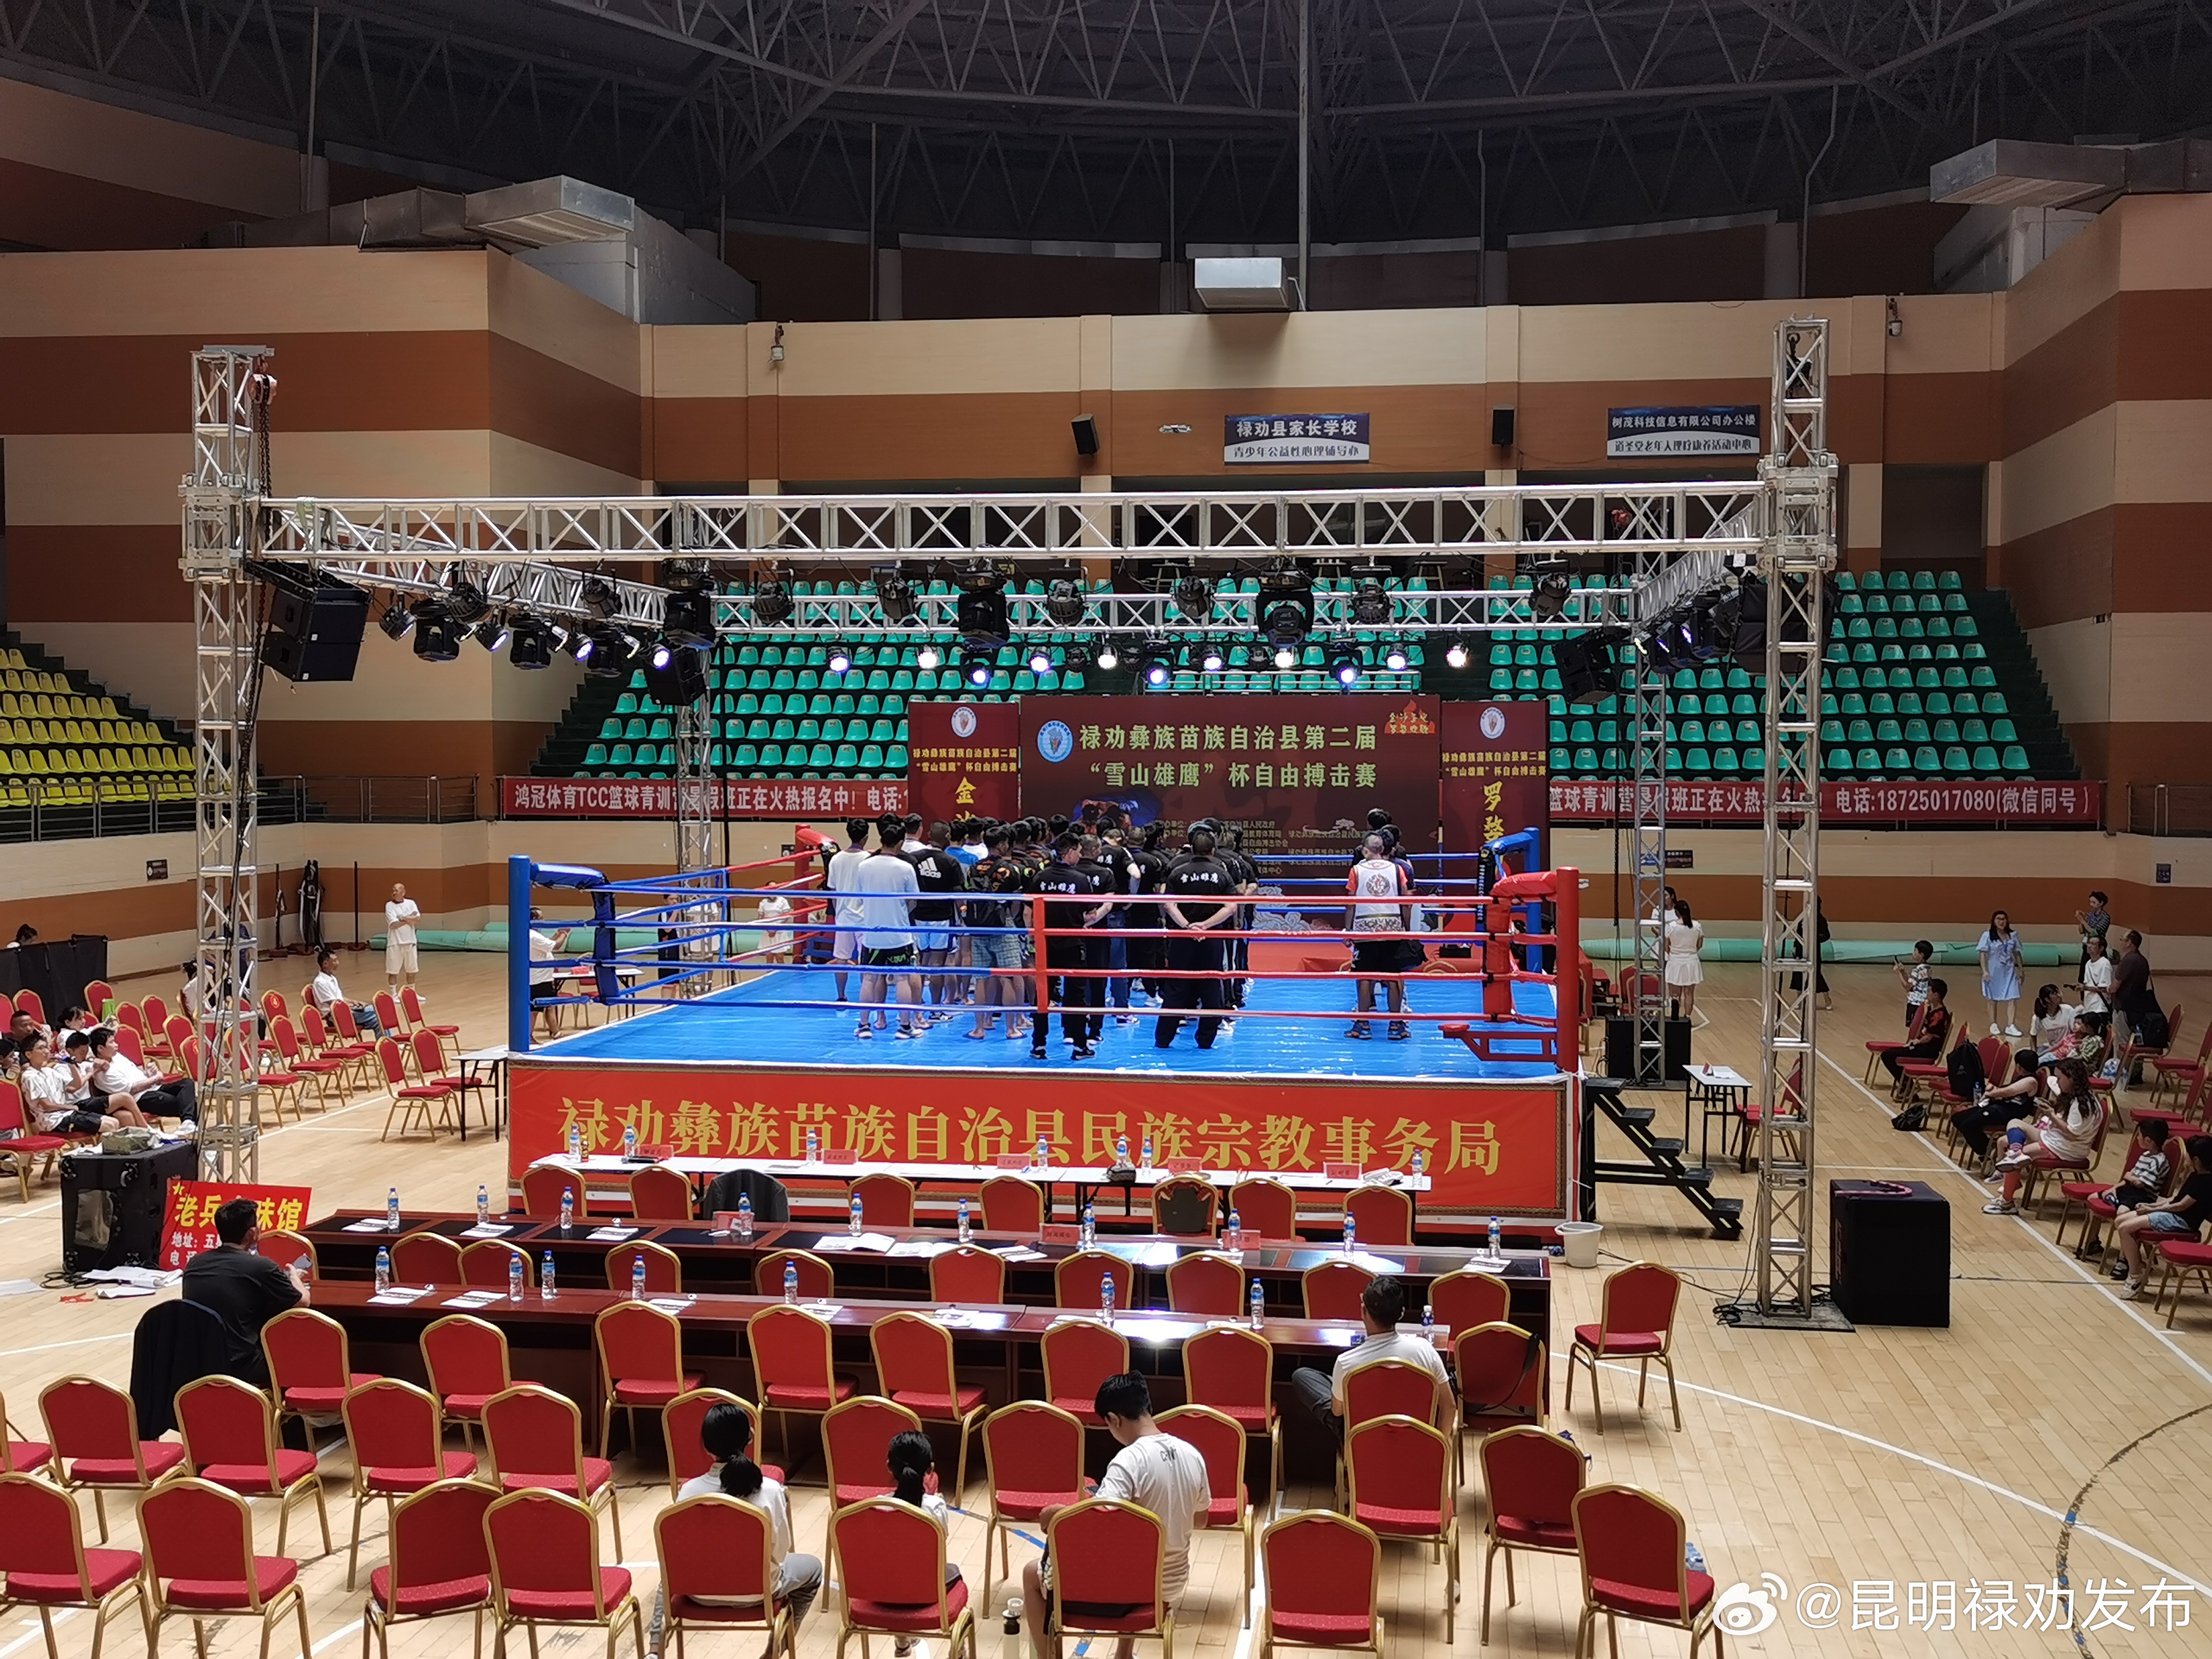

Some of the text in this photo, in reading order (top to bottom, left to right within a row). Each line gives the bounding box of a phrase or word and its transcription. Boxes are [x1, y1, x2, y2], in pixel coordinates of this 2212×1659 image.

[1236, 420, 1358, 437] 禄劝县家长学校
[1079, 725, 1376, 750] 禄劝彝族苗族自治县第二届
[556, 1095, 1503, 1176] 禄劝彝族苗族自治县民族宗教事务局
[173, 1193, 303, 1232] 老兵味馆
